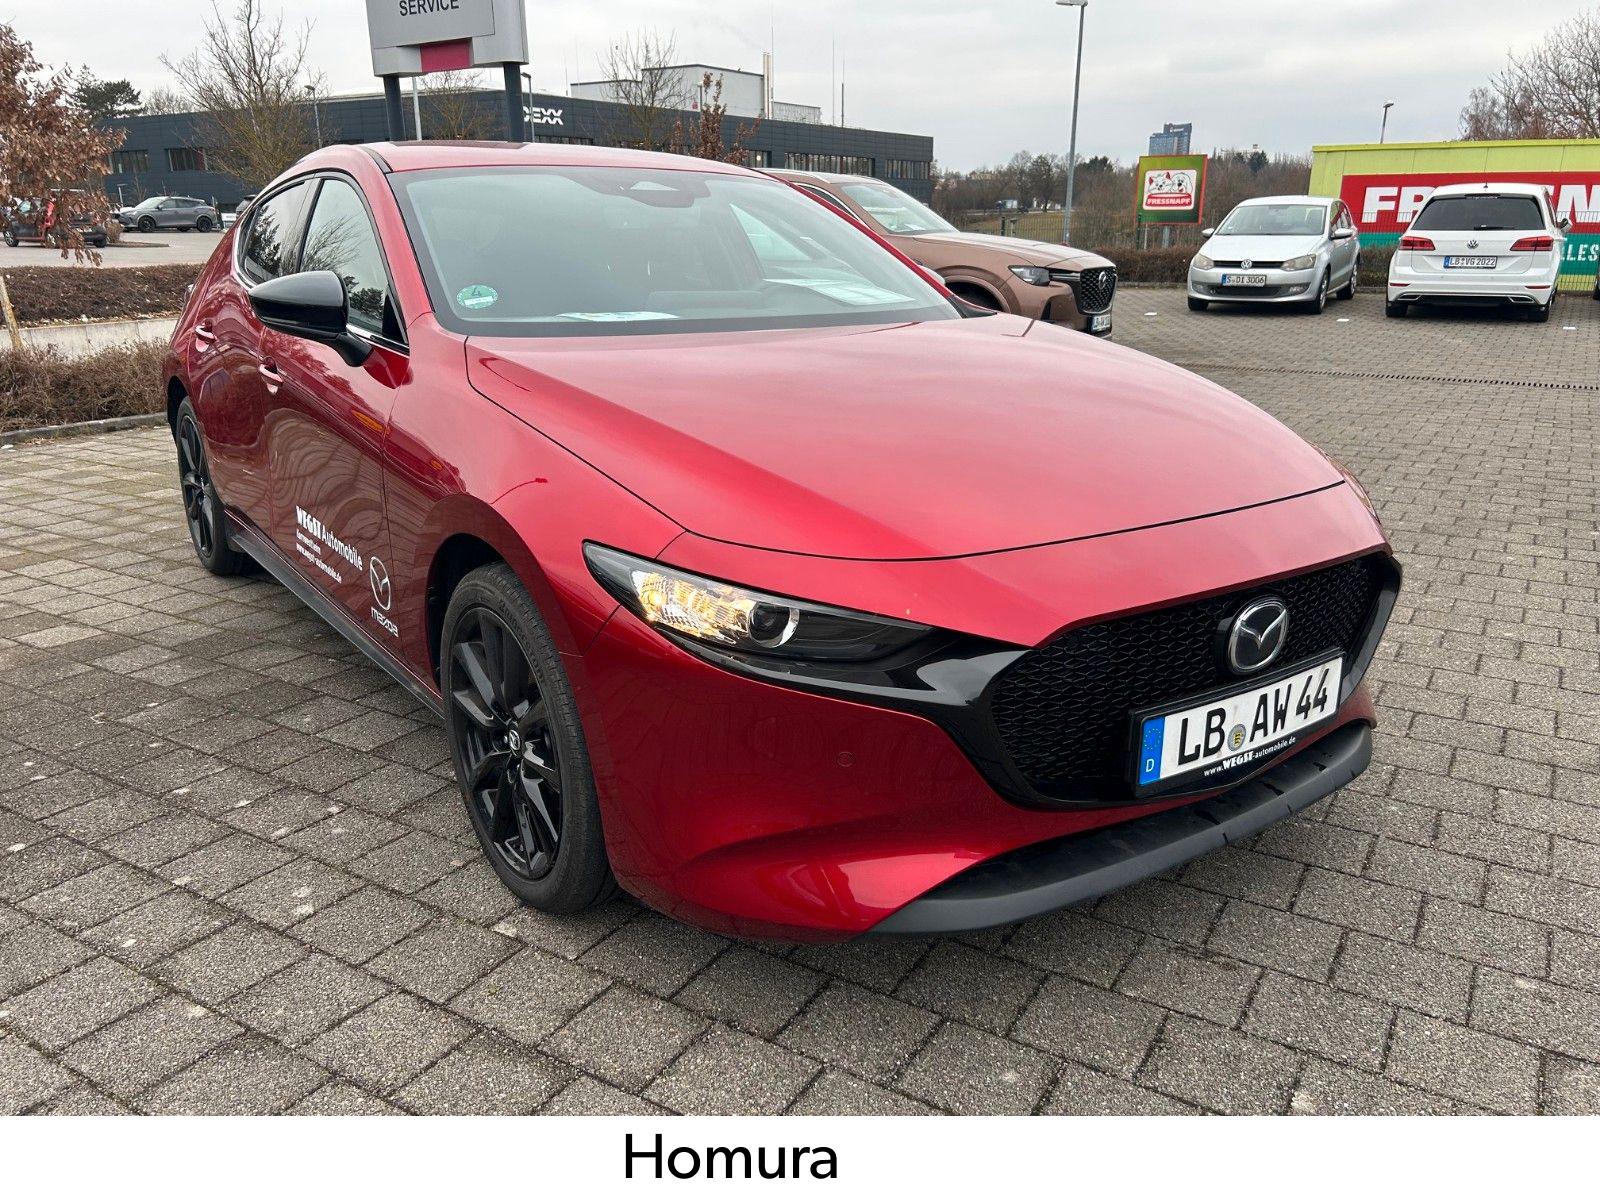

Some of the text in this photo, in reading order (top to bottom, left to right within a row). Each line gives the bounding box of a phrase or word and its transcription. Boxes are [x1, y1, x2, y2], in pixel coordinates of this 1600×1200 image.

[399, 0, 460, 16] SERVICE
[1147, 198, 1191, 206] FRESSNAPF
[1450, 257, 1495, 266] LB VG 2022
[321, 524, 363, 571] Automobile
[1177, 668, 1330, 766] LB AW 44
[1203, 735, 1296, 777] www.WEGST-automobile.de
[1145, 758, 1155, 773] D
